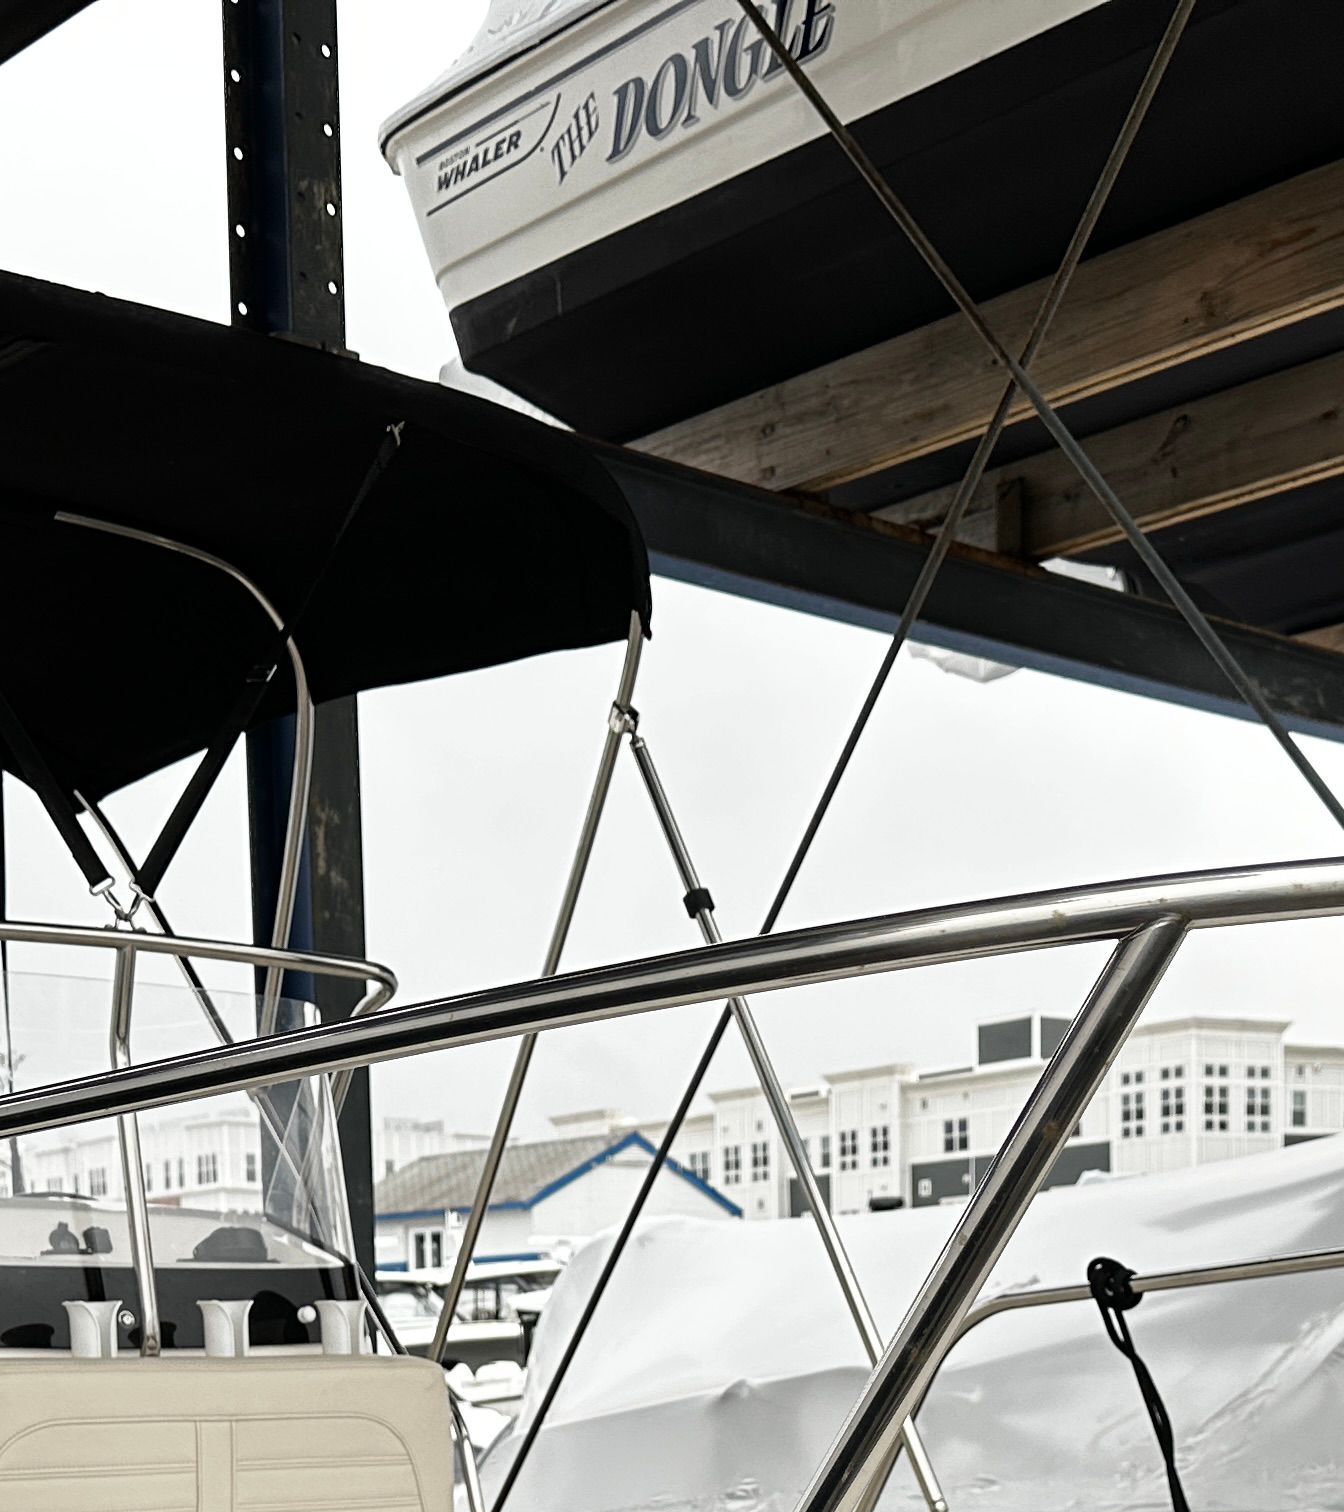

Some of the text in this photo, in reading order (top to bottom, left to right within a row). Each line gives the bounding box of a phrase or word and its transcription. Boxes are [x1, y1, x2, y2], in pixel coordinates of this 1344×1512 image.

[551, 0, 836, 186] THE DONGLE
[436, 129, 522, 193] WHALER
